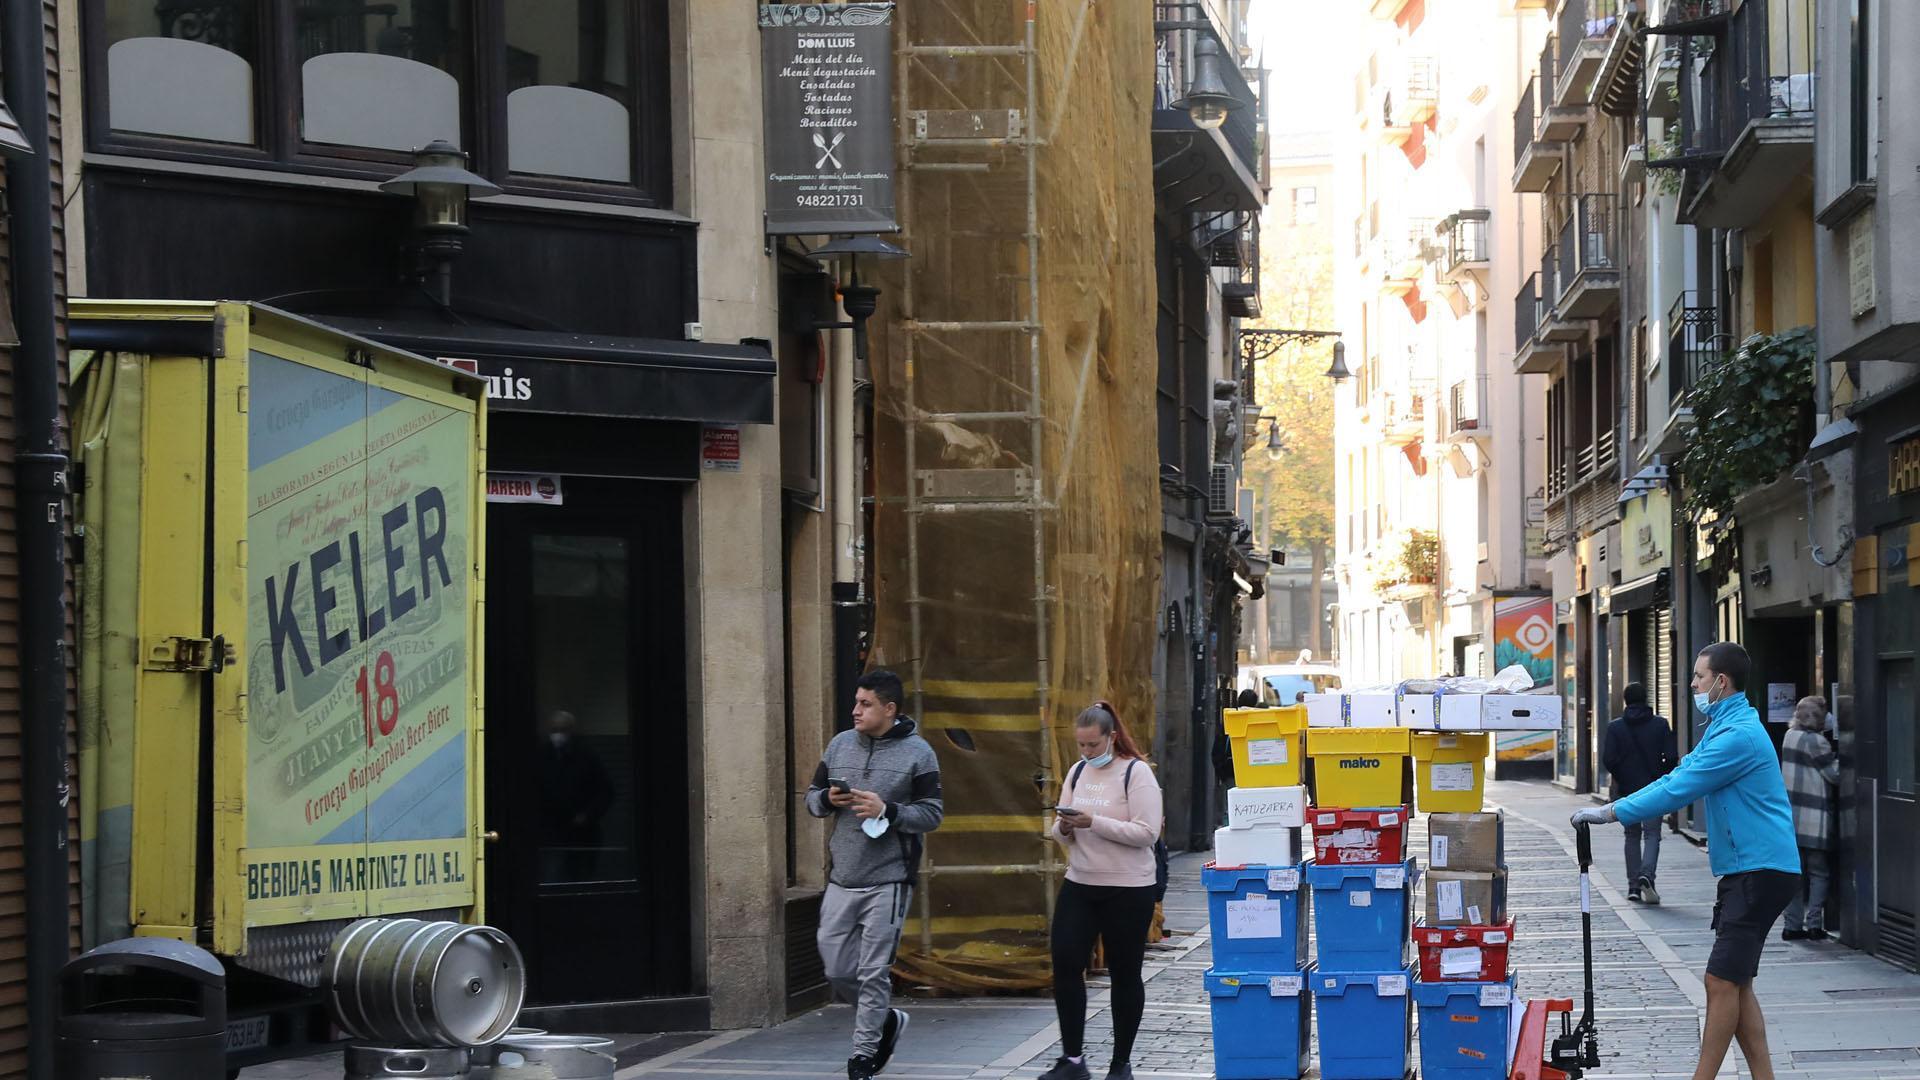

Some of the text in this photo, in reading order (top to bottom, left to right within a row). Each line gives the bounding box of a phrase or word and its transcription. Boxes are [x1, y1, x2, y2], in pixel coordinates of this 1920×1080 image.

[798, 38, 856, 48] DOM LLUIS
[791, 53, 863, 64] Menú del día
[779, 67, 876, 78] Menú degustación
[800, 80, 856, 90] Ensaladas
[804, 93, 852, 102] Tostadas
[804, 105, 852, 115] Raciones
[800, 118, 858, 128] Bocadillos
[796, 195, 863, 207] 948221731
[487, 367, 533, 401] uis
[257, 471, 316, 508] ELABORADA
[317, 454, 349, 478] SEGÚN
[350, 447, 364, 462] LA
[397, 409, 441, 437] ORIGINAL
[265, 486, 452, 695] KELER
[355, 650, 399, 749] 18
[1340, 756, 1381, 769] makro
[305, 782, 347, 826] Cerveza
[406, 721, 426, 751] Beer
[248, 851, 465, 900] BEBIDAS MARTINEZ CIA S.L.
